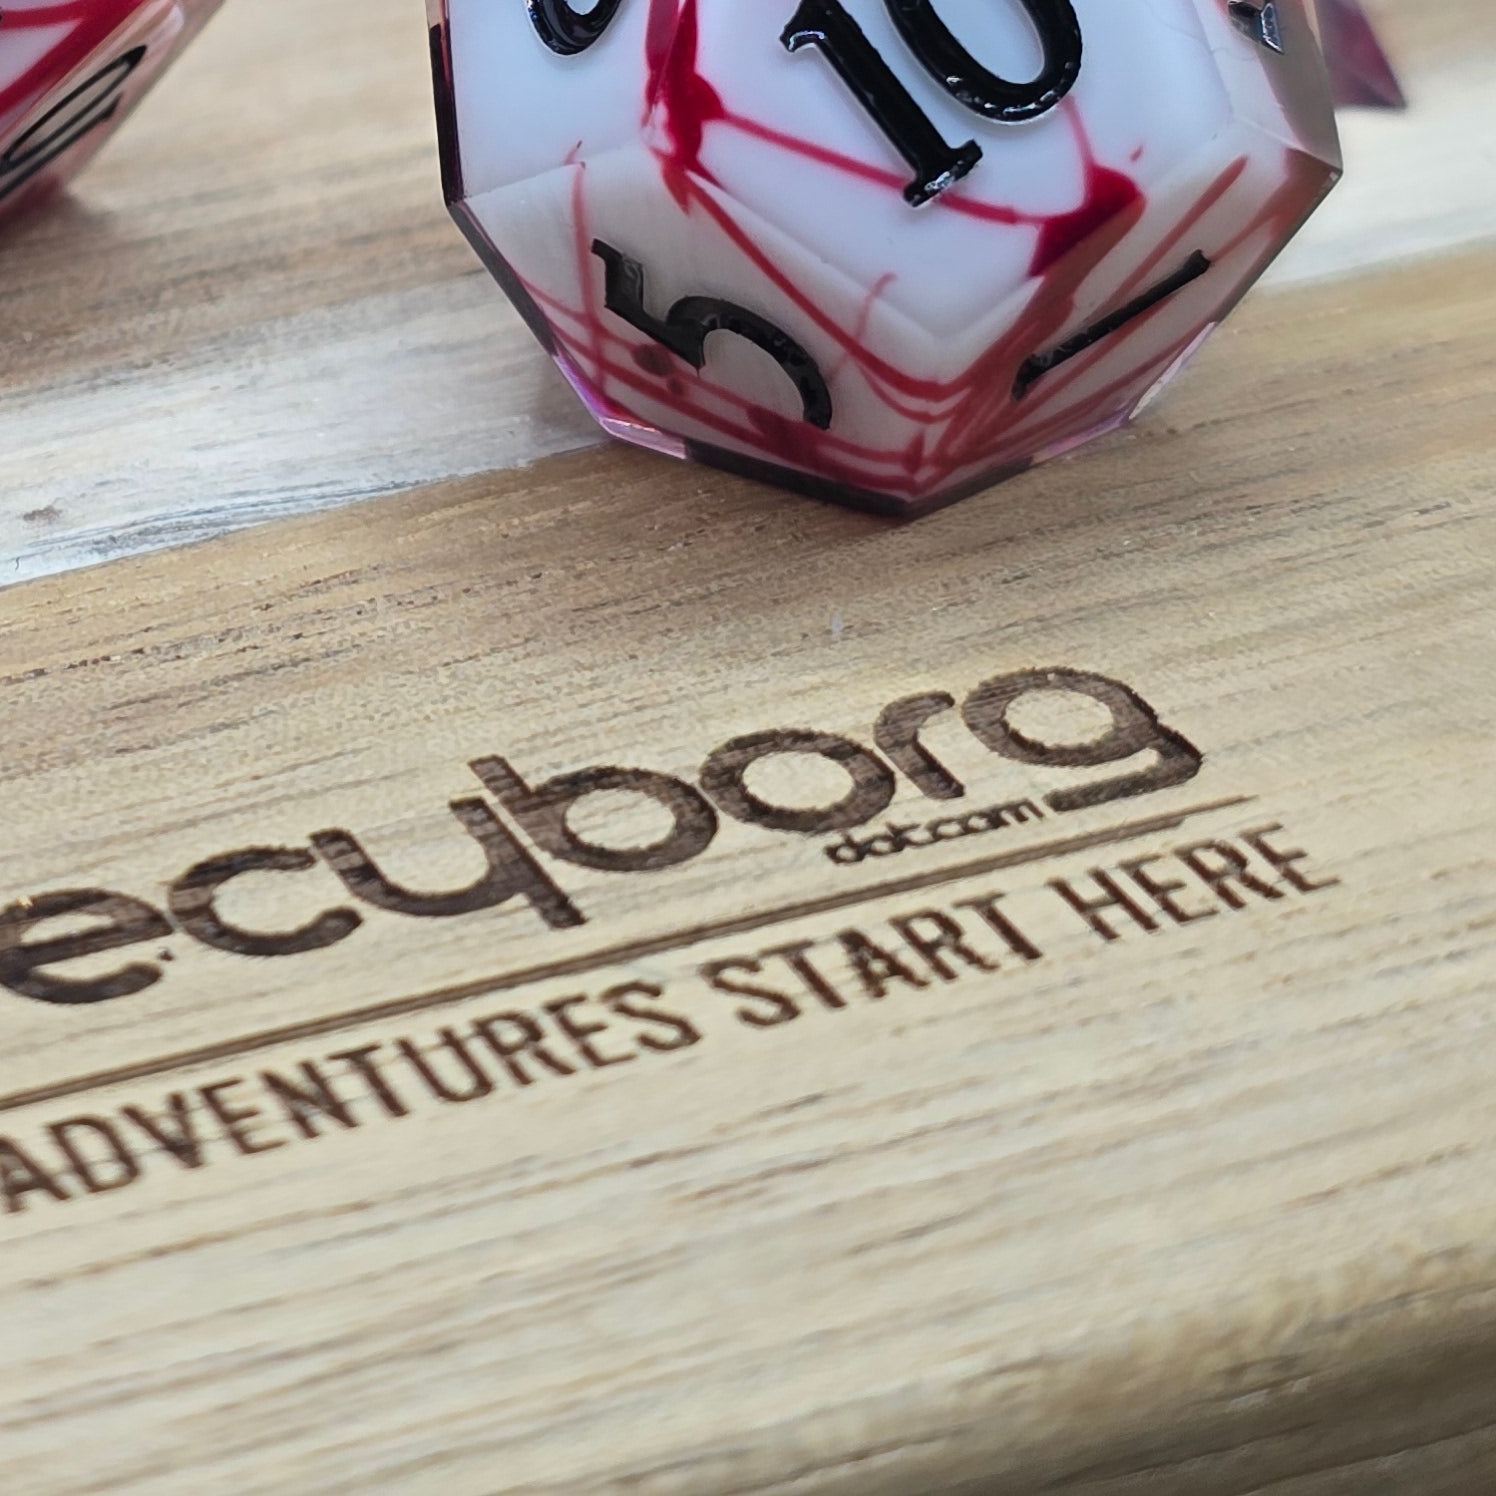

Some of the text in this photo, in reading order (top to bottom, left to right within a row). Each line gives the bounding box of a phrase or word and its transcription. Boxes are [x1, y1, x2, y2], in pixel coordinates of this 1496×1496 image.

[590, 238, 832, 430] 5
[700, 886, 1045, 1029] START
[1046, 821, 1342, 942] HERE
